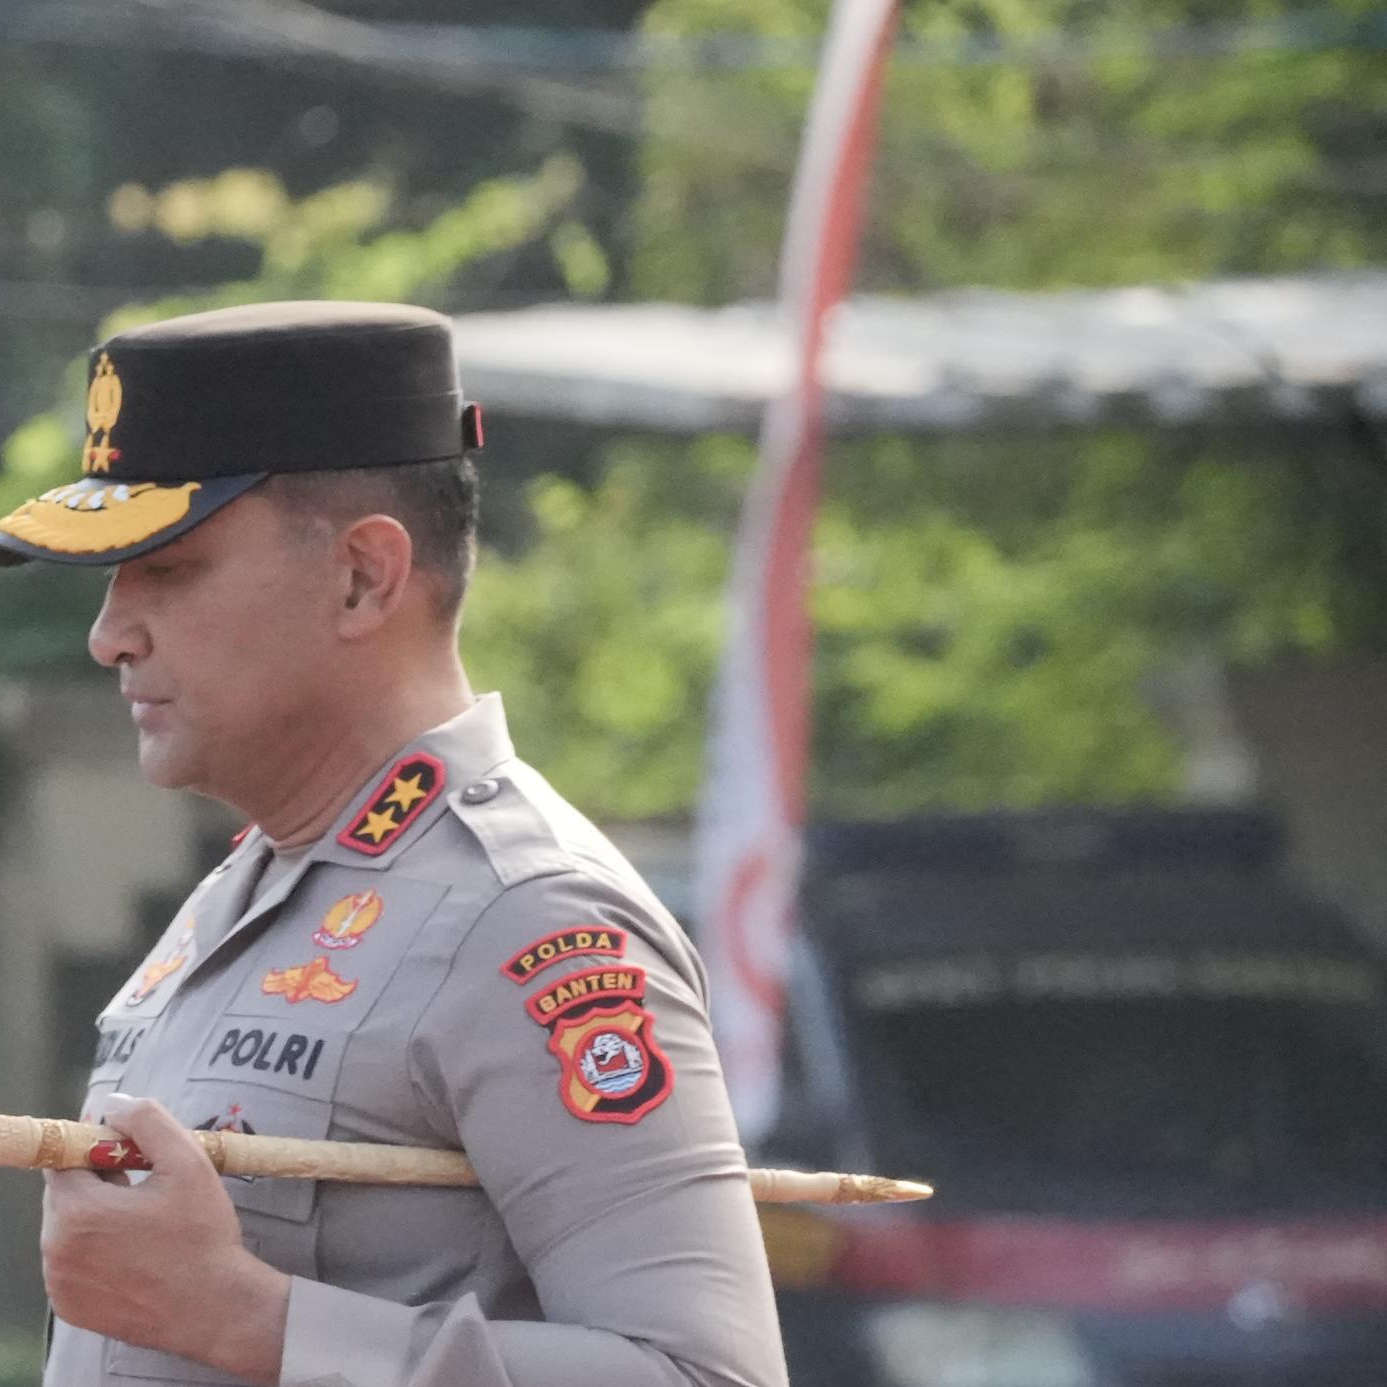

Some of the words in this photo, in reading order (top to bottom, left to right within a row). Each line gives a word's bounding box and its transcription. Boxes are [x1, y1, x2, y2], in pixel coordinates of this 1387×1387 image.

[519, 932, 613, 972] POLDA
[538, 972, 635, 1013] BANTEN
[208, 1028, 325, 1080] POLRI
